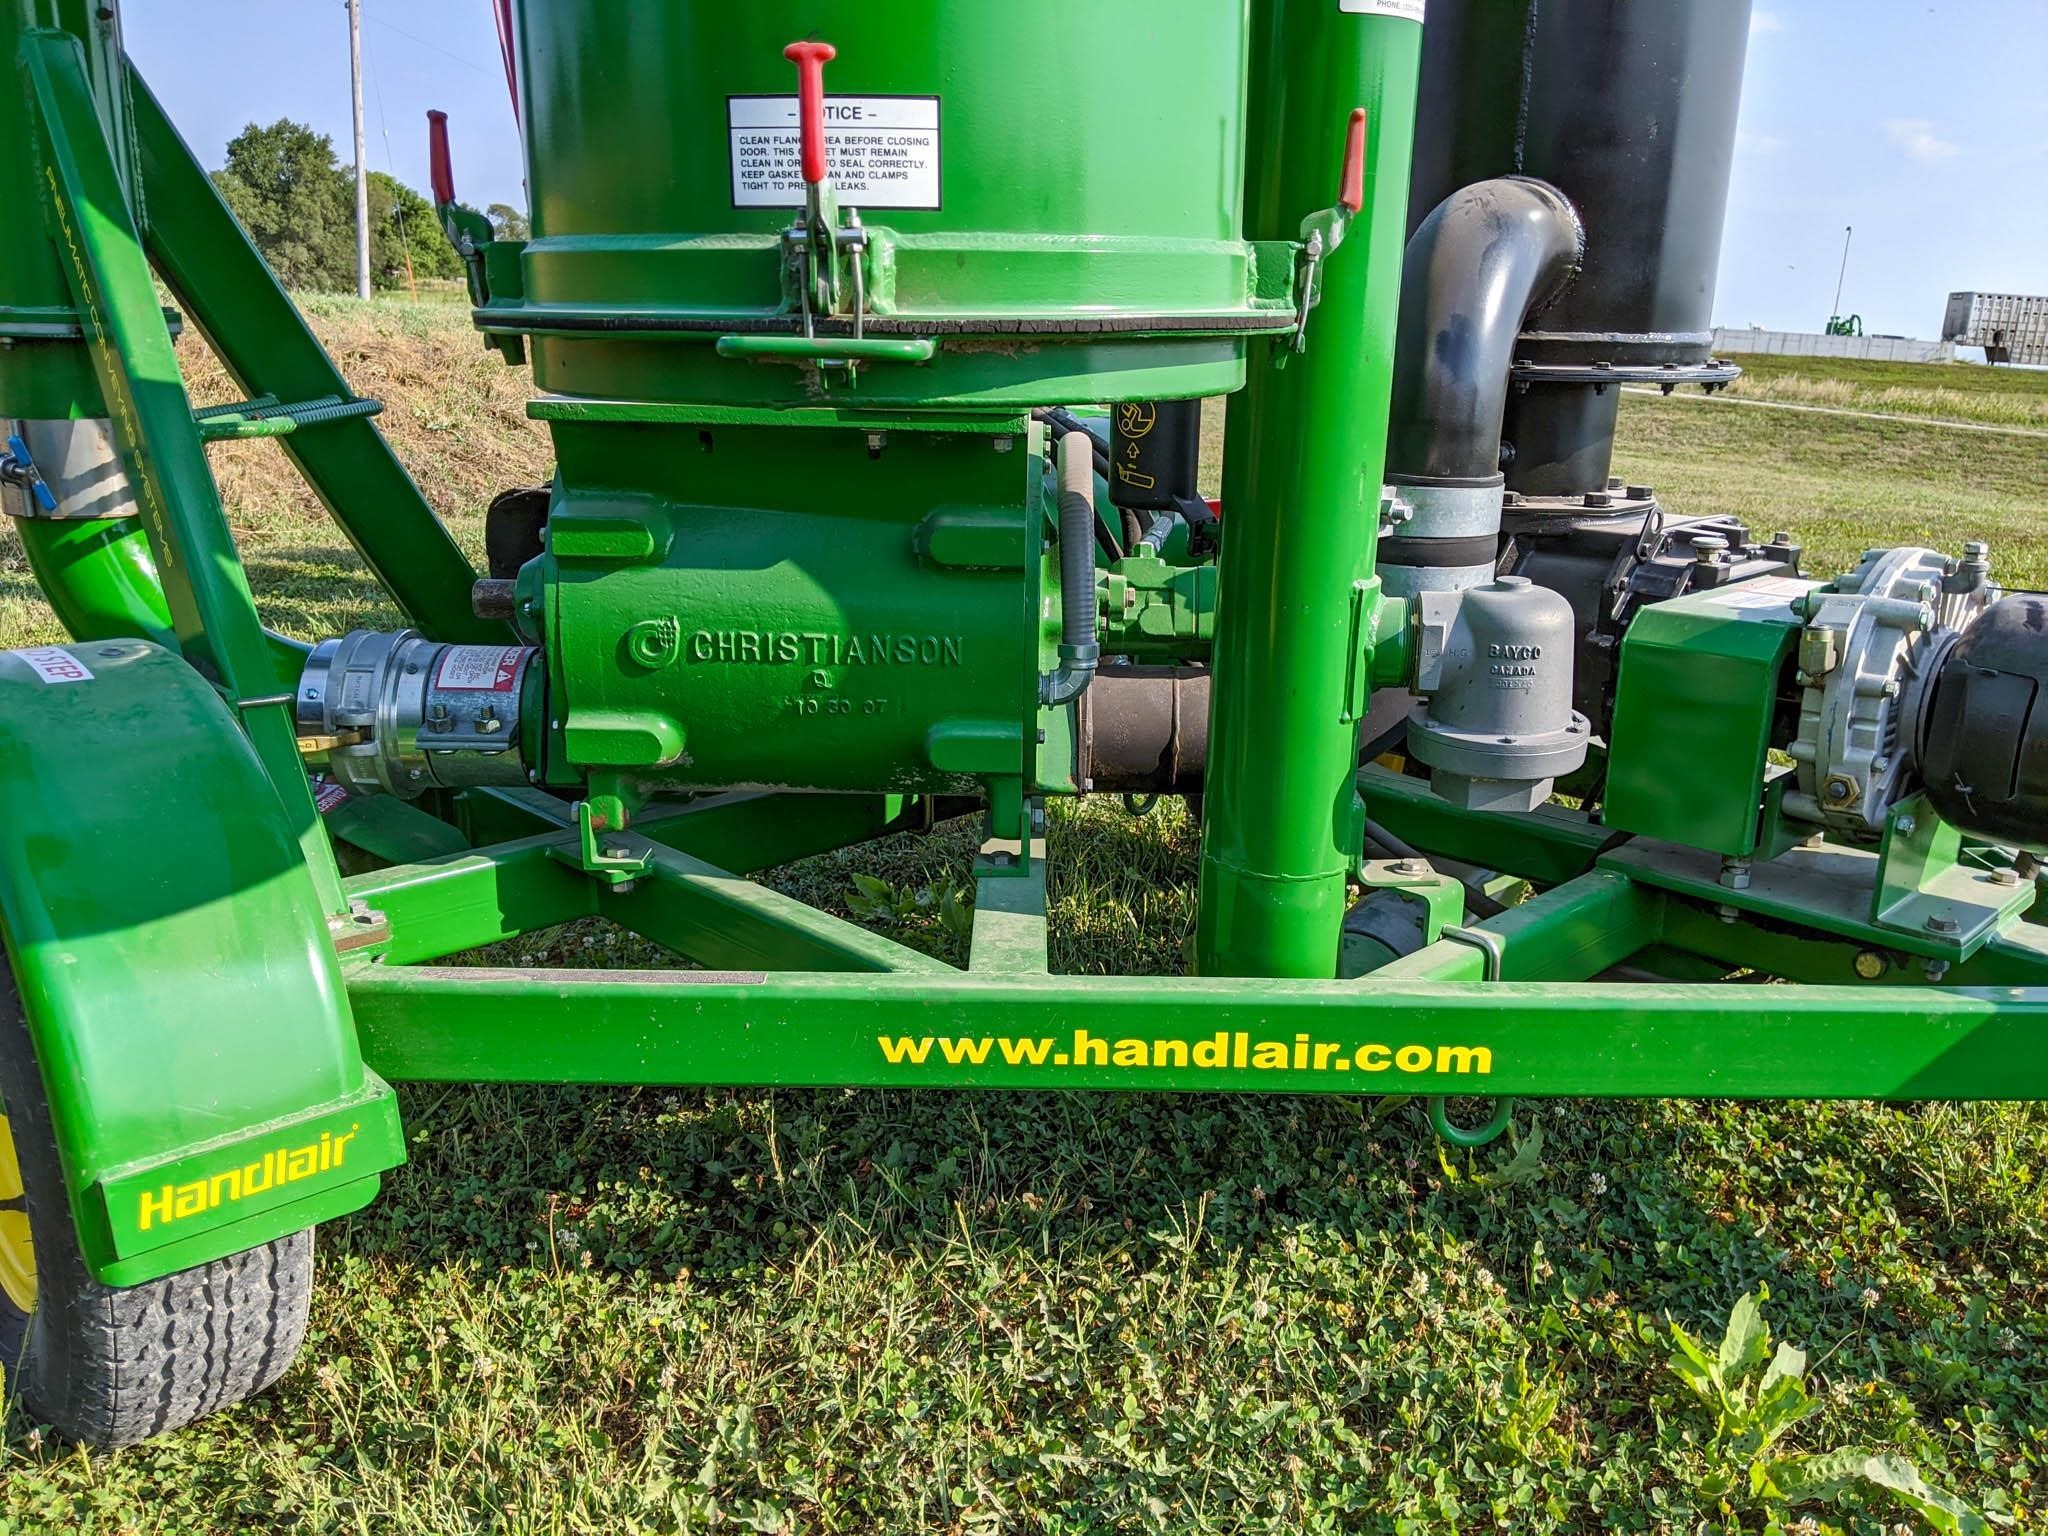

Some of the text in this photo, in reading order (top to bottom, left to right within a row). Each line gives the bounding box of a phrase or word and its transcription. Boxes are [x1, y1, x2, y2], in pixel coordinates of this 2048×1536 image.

[739, 136, 770, 145] CLEAN
[844, 136, 884, 145] BEFORE
[887, 136, 930, 147] CLOSING
[740, 147, 770, 156] DOOR.
[773, 147, 795, 156] THIS
[840, 147, 867, 157] MUST
[870, 148, 908, 157] REMAIN
[740, 159, 771, 168] CLEAN
[774, 159, 784, 168] IN
[840, 159, 865, 168] SEAL
[868, 159, 928, 169] CORRECTLY.
[741, 170, 765, 179] KEEP
[768, 170, 801, 179] GASKE
[844, 171, 865, 179] AND
[868, 171, 909, 180] CLAMPS
[742, 181, 769, 190] TIGHT
[773, 181, 785, 190] TO
[834, 182, 870, 191] LEAKS.
[46, 166, 173, 568] PNEUMATIC CONVEYING SYSTEMS
[694, 631, 963, 665] CHRISTIANSON
[34, 655, 84, 679] STEP
[1489, 664, 1537, 677] CANADA
[877, 1030, 1493, 1074] www.handlair.com
[140, 1127, 357, 1231] Handlair
